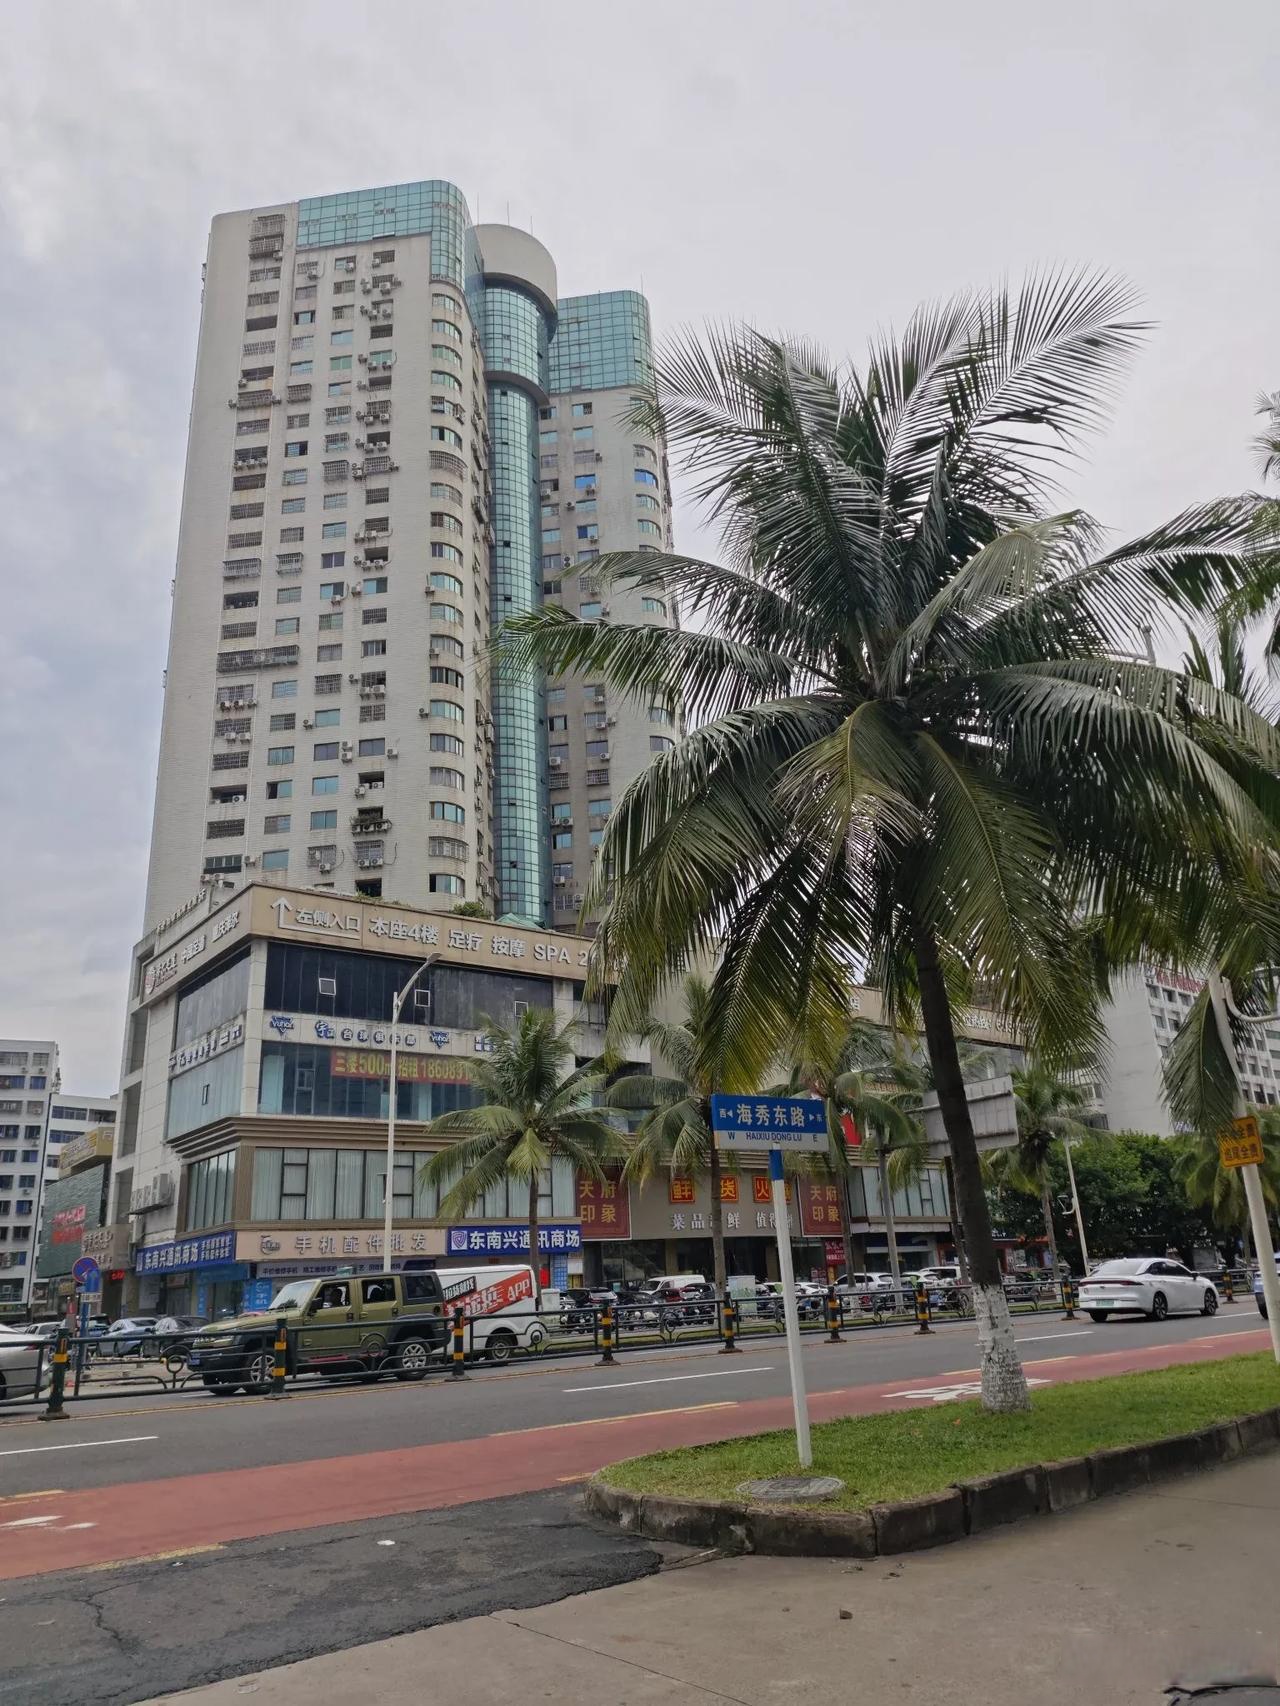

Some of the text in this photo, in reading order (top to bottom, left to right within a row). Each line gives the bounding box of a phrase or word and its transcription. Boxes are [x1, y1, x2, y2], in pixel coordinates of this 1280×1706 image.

[296, 908, 361, 932] 左侧入口
[369, 917, 440, 945] 本座4楼
[448, 929, 483, 951] 足疗
[491, 935, 526, 958] 按摩
[534, 943, 572, 965] SPA
[719, 1103, 823, 1128] 西 海秀东路 东
[728, 1131, 818, 1143] W HAIXIU DONG LU E
[580, 1181, 616, 1198] 天府
[810, 1185, 838, 1201] 天府
[580, 1204, 616, 1223] 印象
[672, 1212, 740, 1231] 菜品鲜
[812, 1205, 840, 1222] 印象
[295, 1234, 427, 1254] 手机配件批发
[469, 1229, 580, 1250] 东南兴通讯商场
[144, 1242, 199, 1270] 东南兴通讯商场
[507, 1278, 530, 1300] APP
